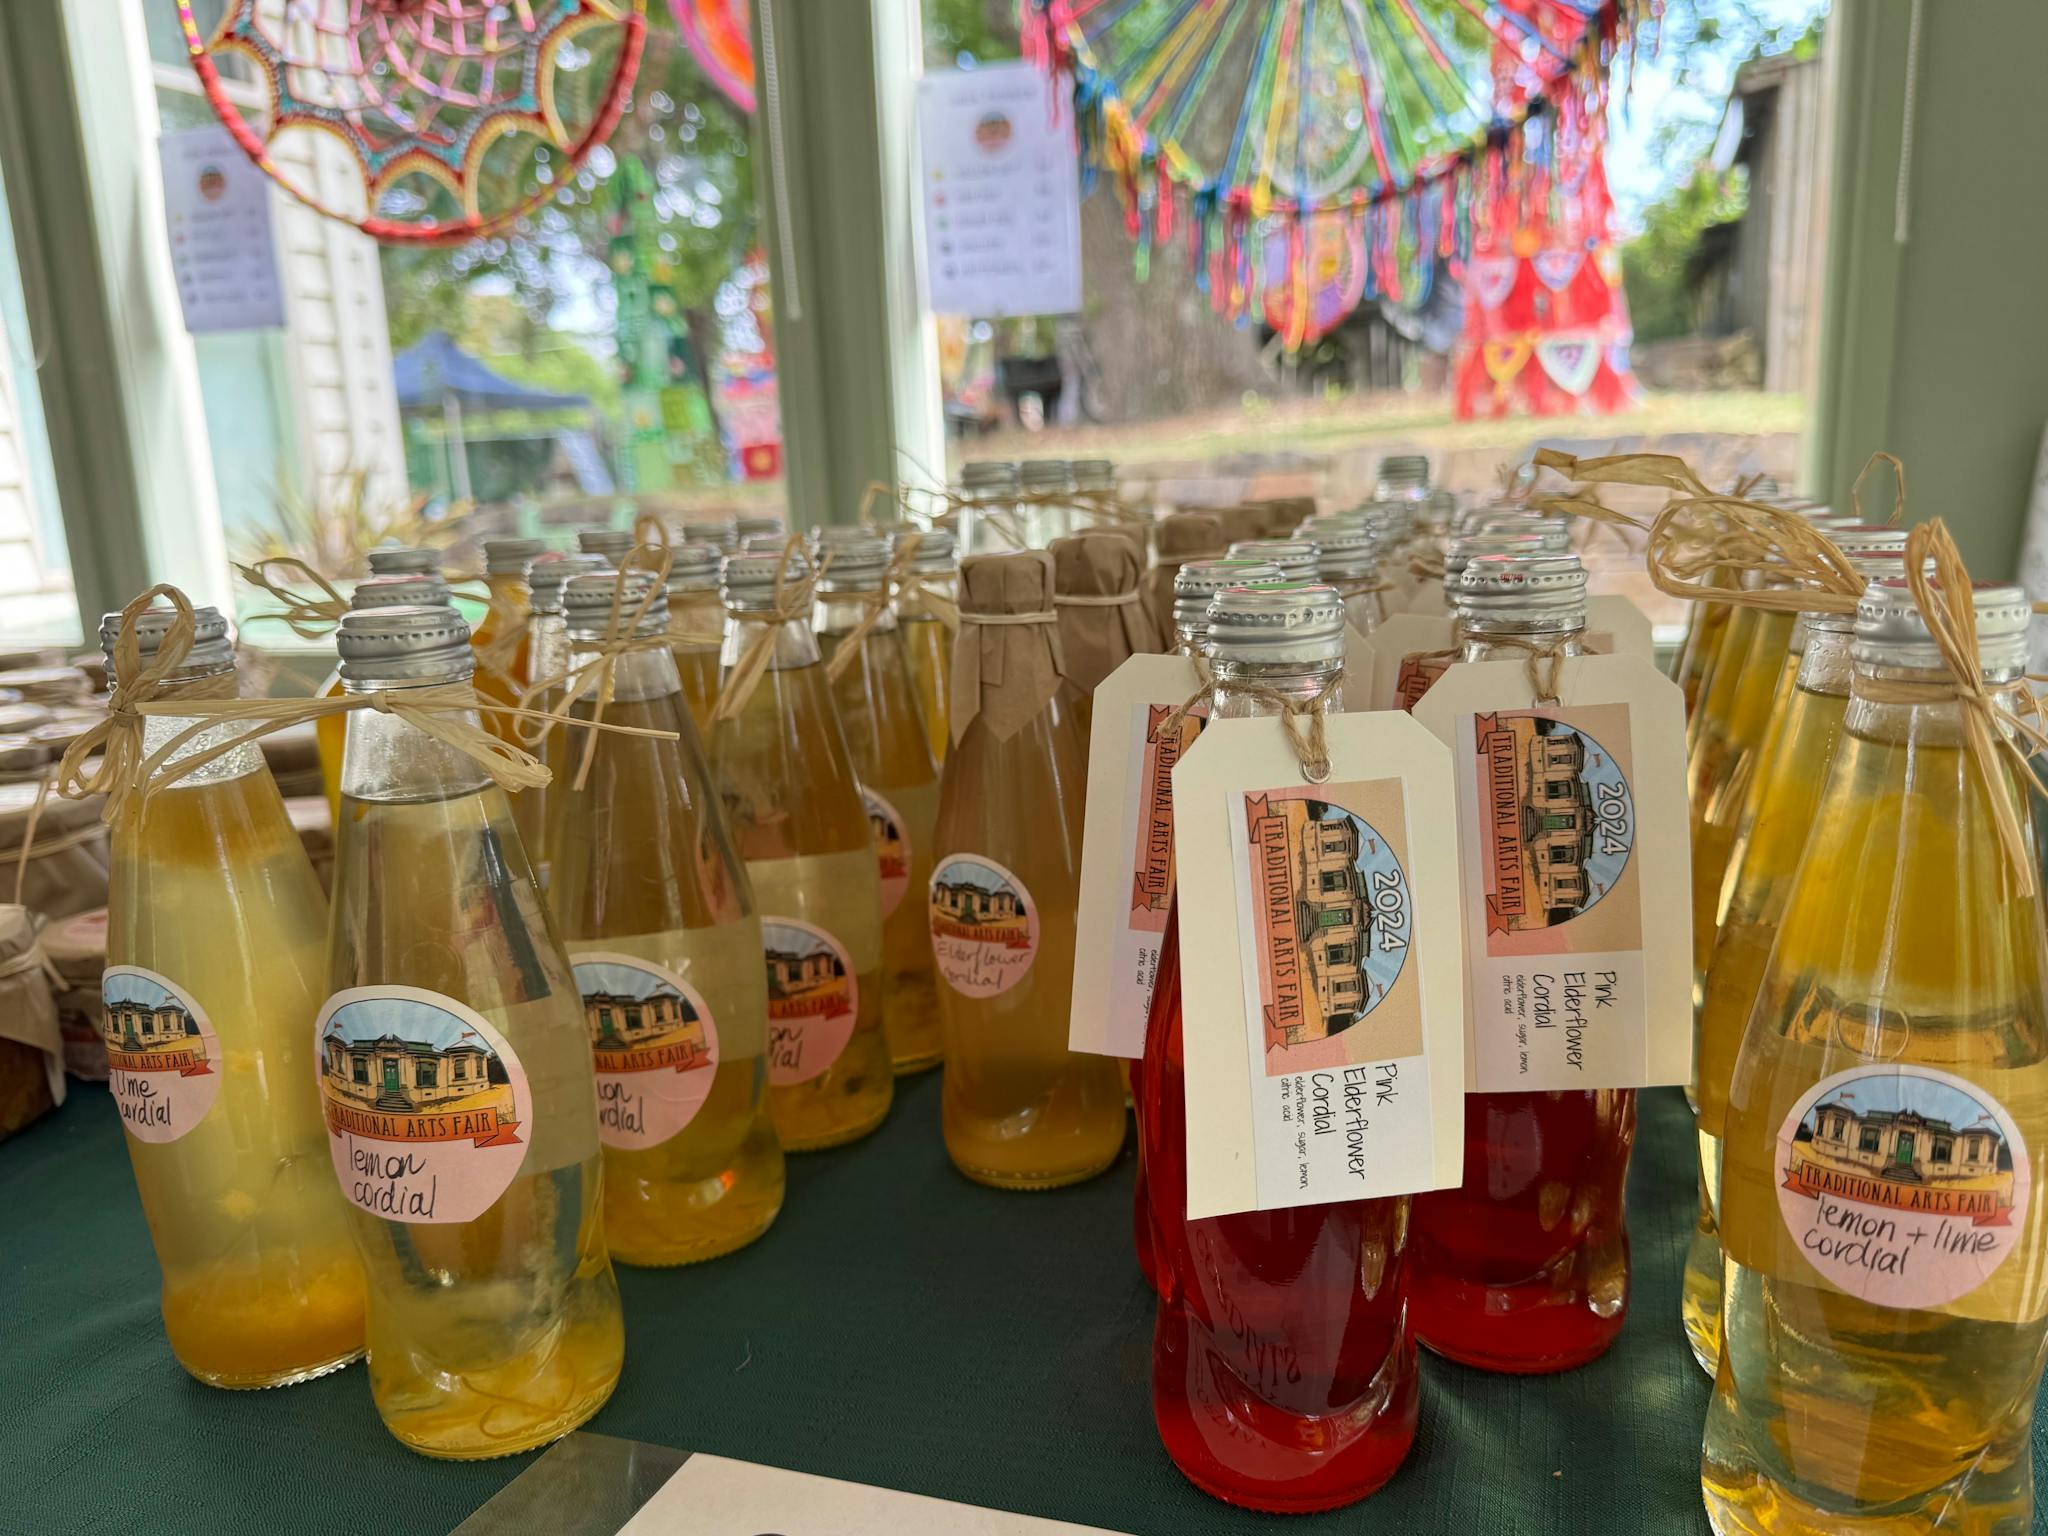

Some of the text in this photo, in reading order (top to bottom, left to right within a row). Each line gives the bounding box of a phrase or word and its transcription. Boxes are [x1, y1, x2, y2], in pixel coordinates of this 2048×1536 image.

[1147, 731, 1177, 888] RADITIONAL ARTS FAIR
[1492, 735, 1521, 910] TRADITIONAL ARTS FAIR
[1598, 782, 1629, 856] 2024
[1263, 821, 1299, 1022] TRADITIONAL ARTS FAIR
[1373, 870, 1407, 952] 2024
[1502, 975, 1514, 1015] citric acid
[1515, 974, 1527, 1020] elderflower,
[1532, 974, 1556, 1029] Cordial
[1594, 970, 1617, 1008] Pink
[1563, 972, 1588, 1071] Elderflower
[140, 1054, 163, 1069] ARTS
[165, 1052, 191, 1068] FAIR
[623, 1051, 654, 1070] ARTS
[658, 1044, 689, 1065] FAIR
[1519, 1051, 1531, 1074] lemon
[1280, 1078, 1293, 1122] citric acid
[1312, 1073, 1336, 1135] Cordial
[1375, 1063, 1398, 1107] Pink
[406, 1117, 446, 1138] ARTS
[453, 1113, 492, 1136] FAIR
[1294, 1075, 1309, 1189] elderflower, sugar, lemon
[1343, 1067, 1369, 1180] Elderflower
[349, 1135, 427, 1180] lemon
[354, 1174, 436, 1219] cordial
[1804, 1165, 1992, 1214] TRADITIONAL ARTS FAIR
[1816, 1197, 2001, 1255] lemon + lime
[1803, 1227, 1910, 1275] cordial
